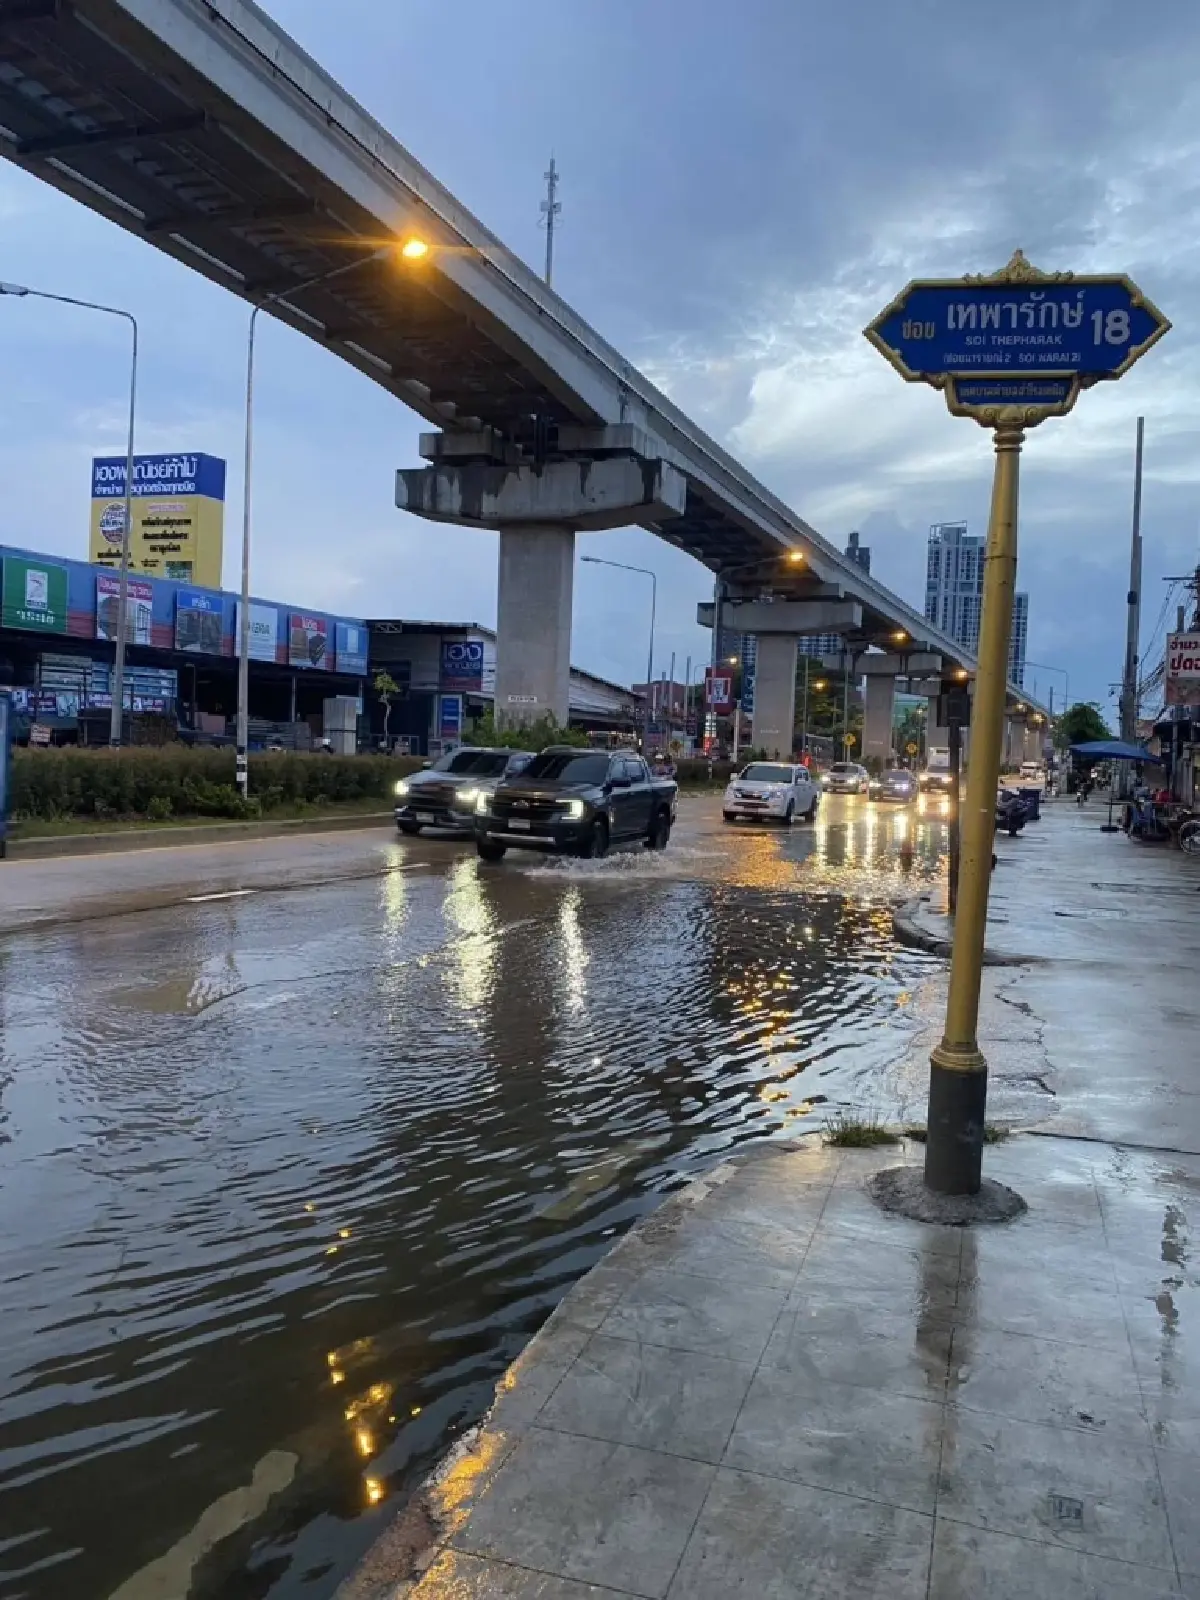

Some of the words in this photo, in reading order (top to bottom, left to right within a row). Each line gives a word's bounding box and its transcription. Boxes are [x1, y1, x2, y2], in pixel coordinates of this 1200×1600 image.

[902, 319, 935, 340] ซอย
[947, 290, 1085, 331] เทพารักษ์
[1091, 310, 1131, 345] 18
[965, 335, 986, 346] SOI
[991, 334, 1063, 346] THEPHARAK
[1018, 352, 1036, 364] SOI
[95, 456, 198, 481] เฮงพณิชย์ค้าไม้
